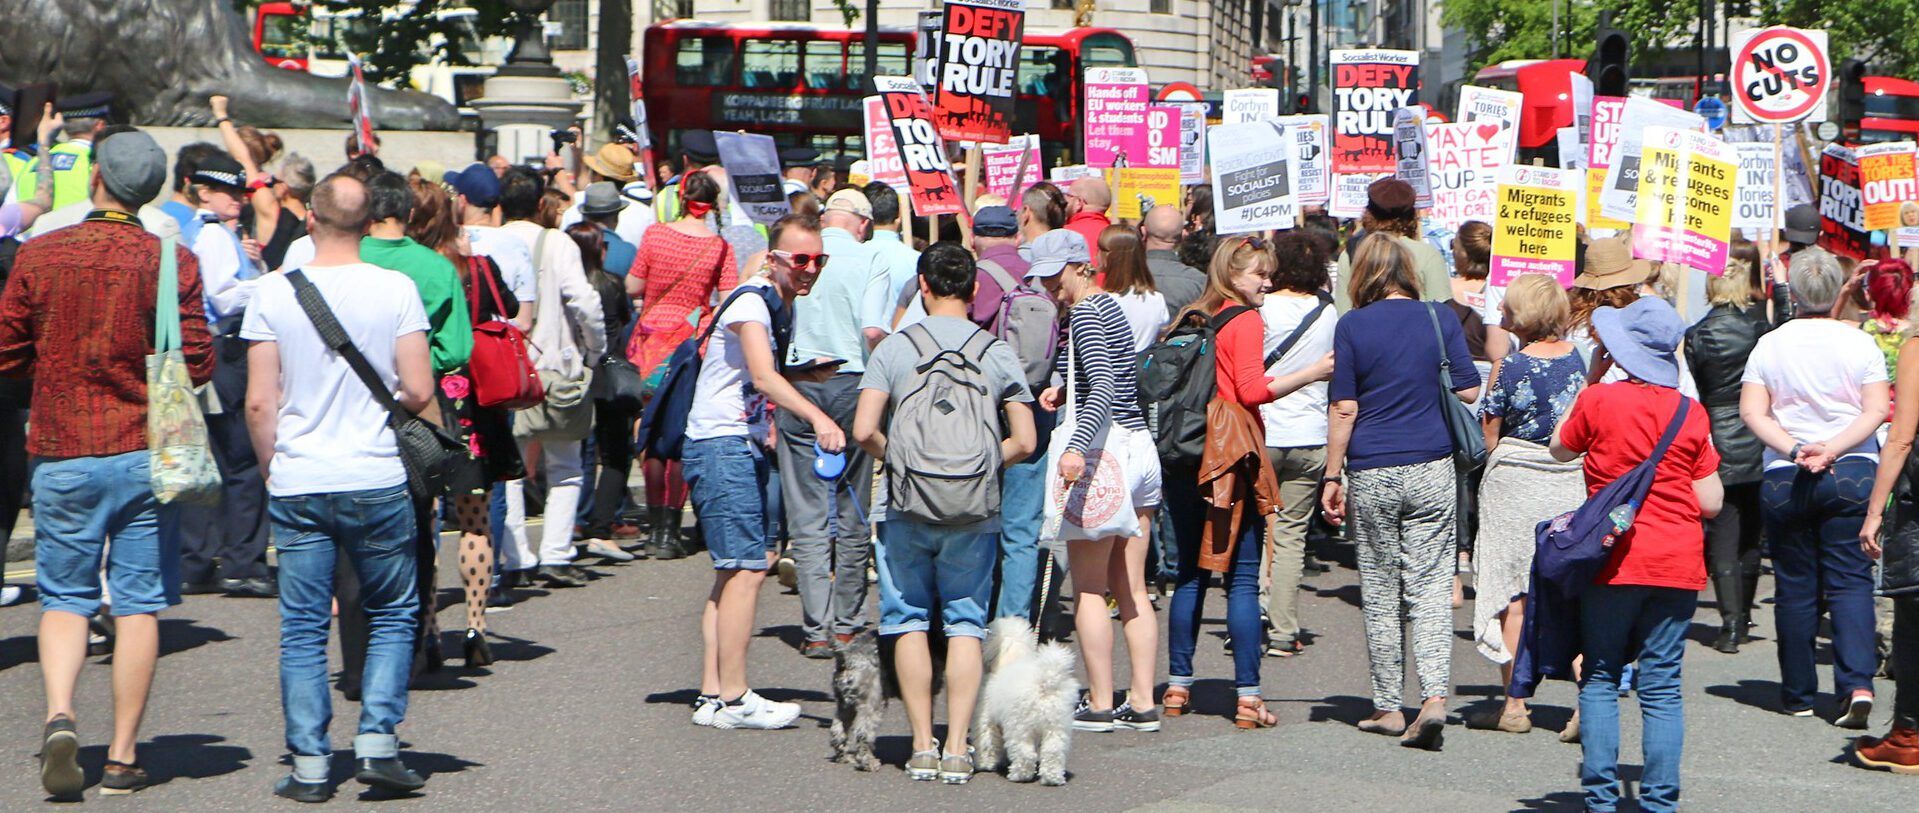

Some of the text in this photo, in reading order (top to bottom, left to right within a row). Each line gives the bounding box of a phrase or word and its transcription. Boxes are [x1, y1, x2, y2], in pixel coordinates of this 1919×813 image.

[949, 5, 1021, 40] DEFY
[945, 33, 1019, 69] TORY
[1342, 53, 1408, 63] Socialist Worker
[1751, 43, 1799, 73] NO
[943, 62, 1015, 98] RULE
[1336, 64, 1412, 89] DEFY
[1747, 65, 1820, 102] CUTS
[1088, 86, 1138, 99] Hands off
[1335, 87, 1414, 111] TORY
[724, 94, 802, 110] KOPPARBERG
[804, 96, 838, 110] FRUIT
[1088, 98, 1104, 111] EU
[1105, 100, 1146, 112] workers
[1230, 98, 1269, 114] Corbyn
[1474, 101, 1508, 116] TORIES
[723, 109, 802, 124] YEAH, LAGER.
[1088, 112, 1144, 124] & students
[1240, 112, 1257, 122] IN
[1595, 101, 1624, 122] ST
[893, 118, 936, 145] TO
[1088, 125, 1134, 137] Let them
[1088, 137, 1112, 151] stay
[1593, 144, 1614, 164] R
[1889, 154, 1913, 167] THE
[988, 165, 1001, 176] EU
[1234, 166, 1269, 183] Fight for
[1747, 170, 1765, 185] IN
[1863, 165, 1914, 182] TORIES
[1227, 174, 1282, 197] SOCIALIST
[1645, 168, 1657, 184] &
[1662, 174, 1730, 200] reugees
[1863, 178, 1917, 204] OUT!
[1242, 189, 1272, 206] policies
[1508, 188, 1566, 207] Migrants
[1738, 186, 1774, 202] Tories
[1241, 203, 1292, 222] #JC4PM
[1653, 192, 1720, 216] ecome
[1739, 203, 1774, 219] OUT
[1500, 204, 1509, 219] &
[1514, 207, 1572, 225] refugees
[1819, 194, 1867, 234] RULE
[1506, 223, 1563, 240] welcome
[1520, 239, 1548, 255] here
[1501, 258, 1527, 269] Blame
